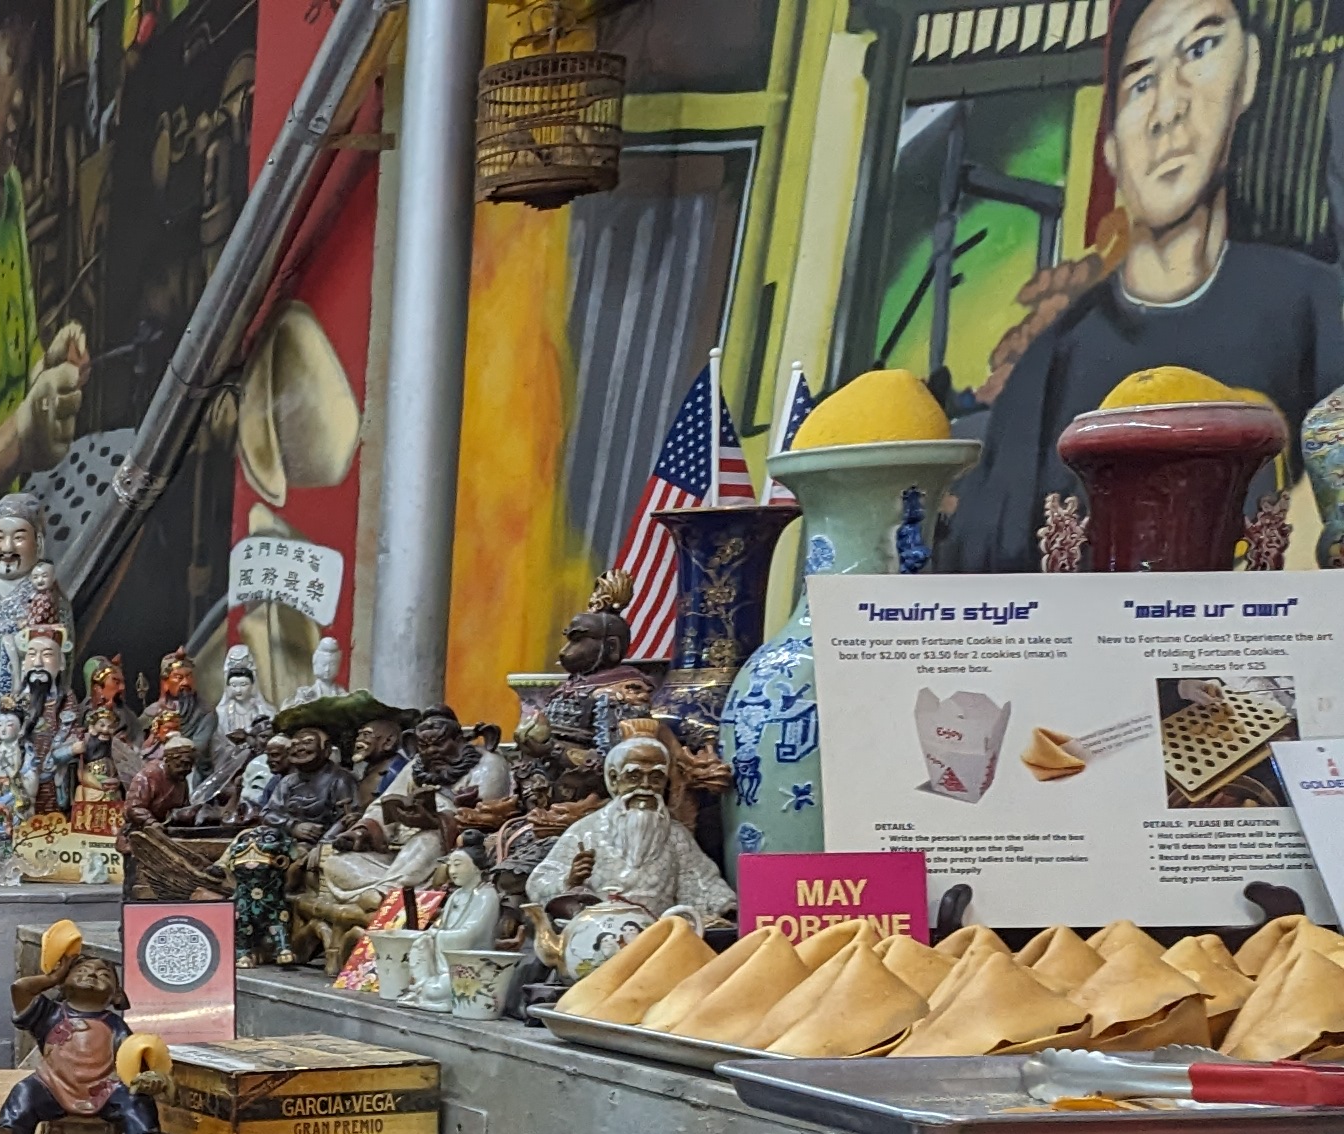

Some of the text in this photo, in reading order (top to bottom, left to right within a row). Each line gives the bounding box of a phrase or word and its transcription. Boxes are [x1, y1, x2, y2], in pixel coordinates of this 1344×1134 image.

[963, 602, 1038, 625] style"
[1203, 603, 1234, 618] ur
[831, 638, 866, 646] Create
[869, 638, 892, 648] your
[897, 638, 918, 646] own
[922, 637, 963, 645] Fortune
[967, 637, 1002, 645] Cookie
[1028, 636, 1051, 644] take
[1139, 635, 1181, 643] Fortune
[1184, 634, 1230, 643] Cookies?
[1234, 634, 1292, 643] Experience
[1295, 633, 1313, 641] the
[839, 652, 858, 660] box
[862, 651, 877, 660] for
[880, 651, 907, 660] $2.00
[924, 651, 951, 660] $3.50
[954, 651, 969, 659] for
[972, 651, 978, 659] 2
[981, 651, 1021, 659] cookies
[1025, 651, 1054, 660] (max)
[1144, 648, 1289, 659] of folding Fortune Cookies.
[917, 665, 934, 673] the
[969, 665, 991, 673] box.
[1173, 662, 1266, 671] 3 minutes for $25
[936, 727, 963, 741] Enjoy
[875, 823, 915, 831] DETAILS:
[951, 867, 981, 875] happily
[796, 878, 868, 907] MAY
[755, 914, 912, 942] FORNE
[282, 1097, 345, 1116] GARCIA
[352, 1093, 395, 1113] VEGA
